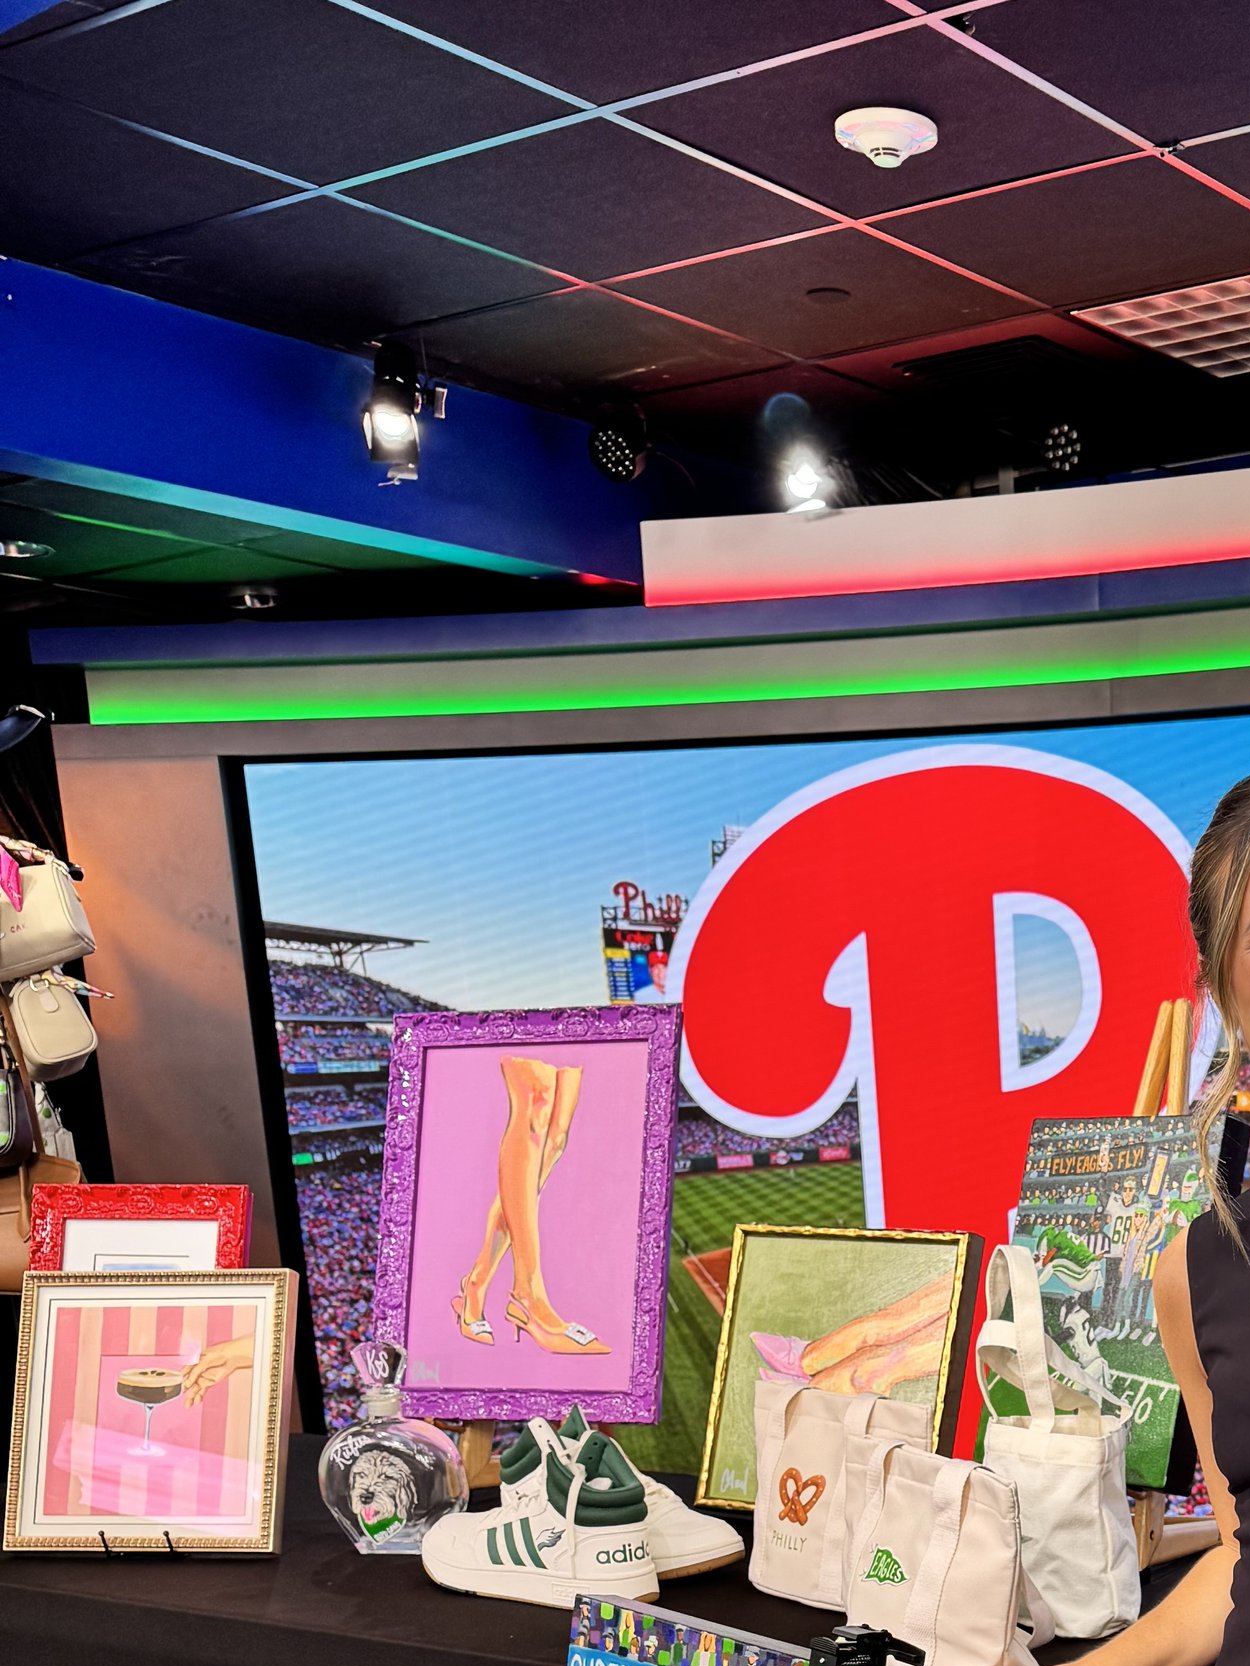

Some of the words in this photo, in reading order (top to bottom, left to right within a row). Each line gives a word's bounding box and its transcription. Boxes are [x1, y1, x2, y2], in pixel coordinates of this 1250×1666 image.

[1076, 1154, 1113, 1173] EAGLS
[1117, 1146, 1144, 1169] FLY!
[772, 1530, 808, 1552] PHILLY
[870, 1552, 903, 1583] EAGLES
